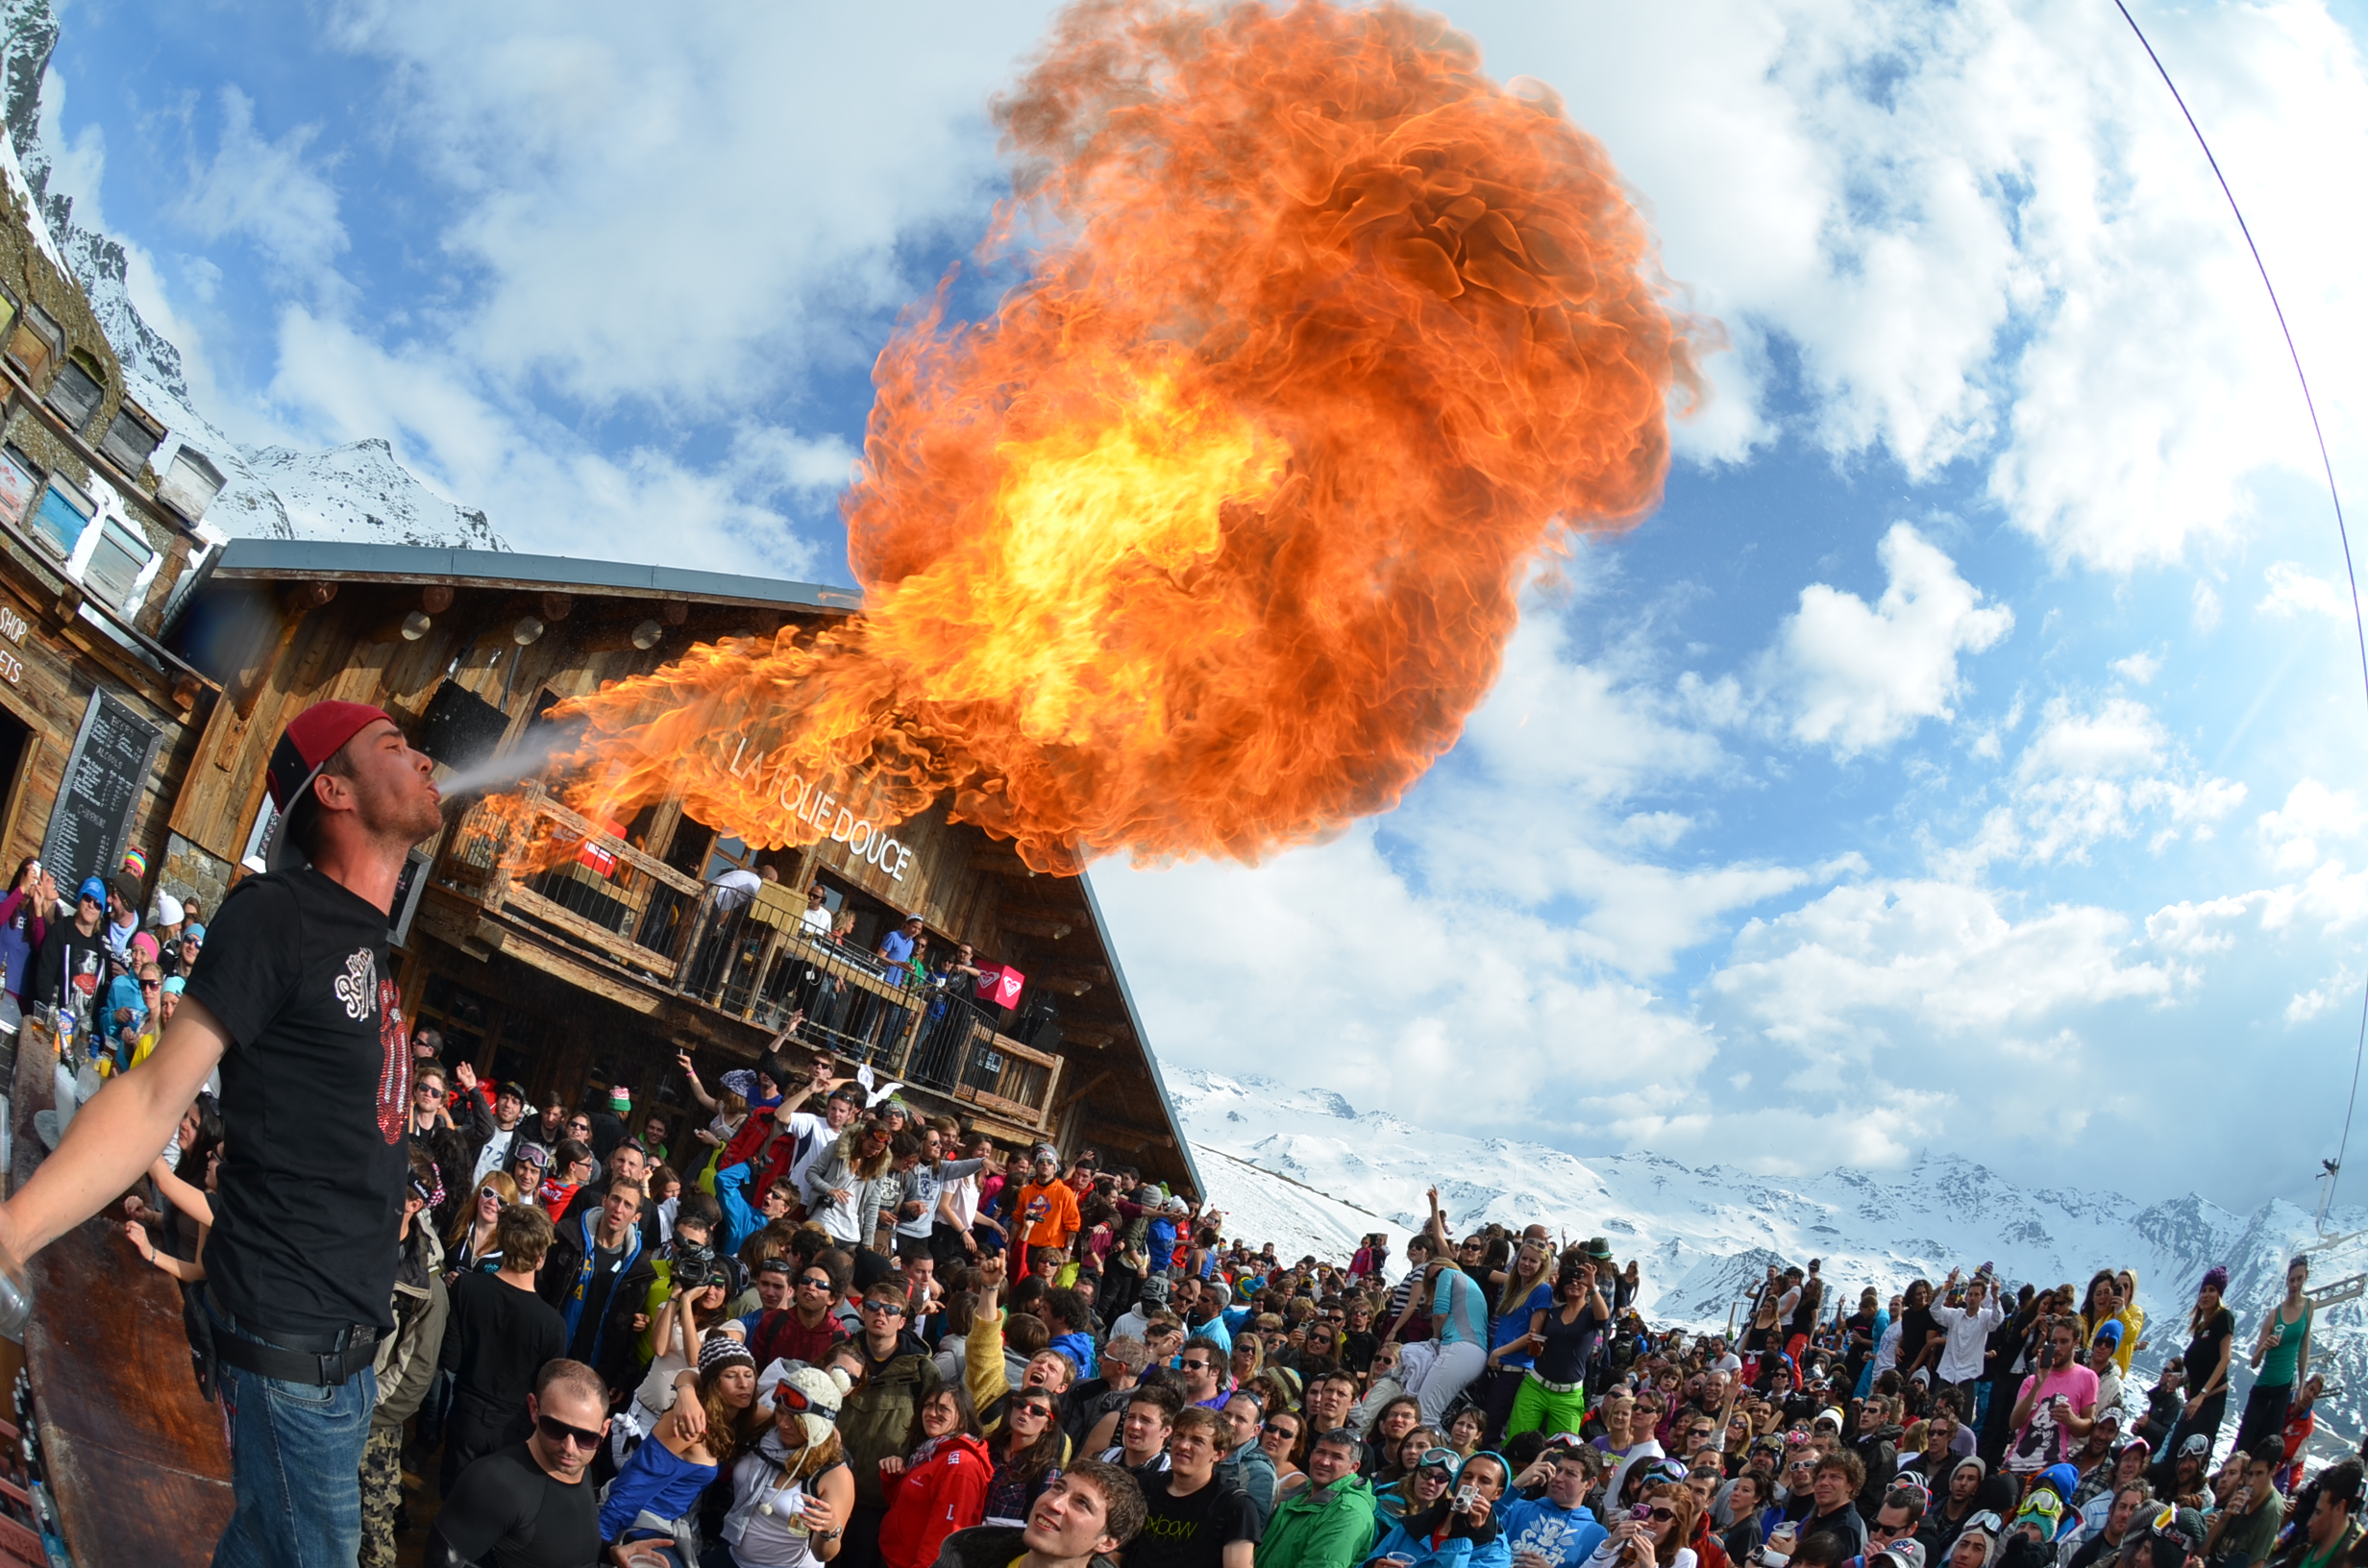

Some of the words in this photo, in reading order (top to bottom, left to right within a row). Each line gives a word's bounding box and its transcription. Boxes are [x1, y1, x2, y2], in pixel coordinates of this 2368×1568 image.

[0, 606, 28, 643] SHOP
[728, 737, 764, 791] LA
[766, 763, 835, 832] FOLIE
[830, 807, 912, 882] DOUCE
